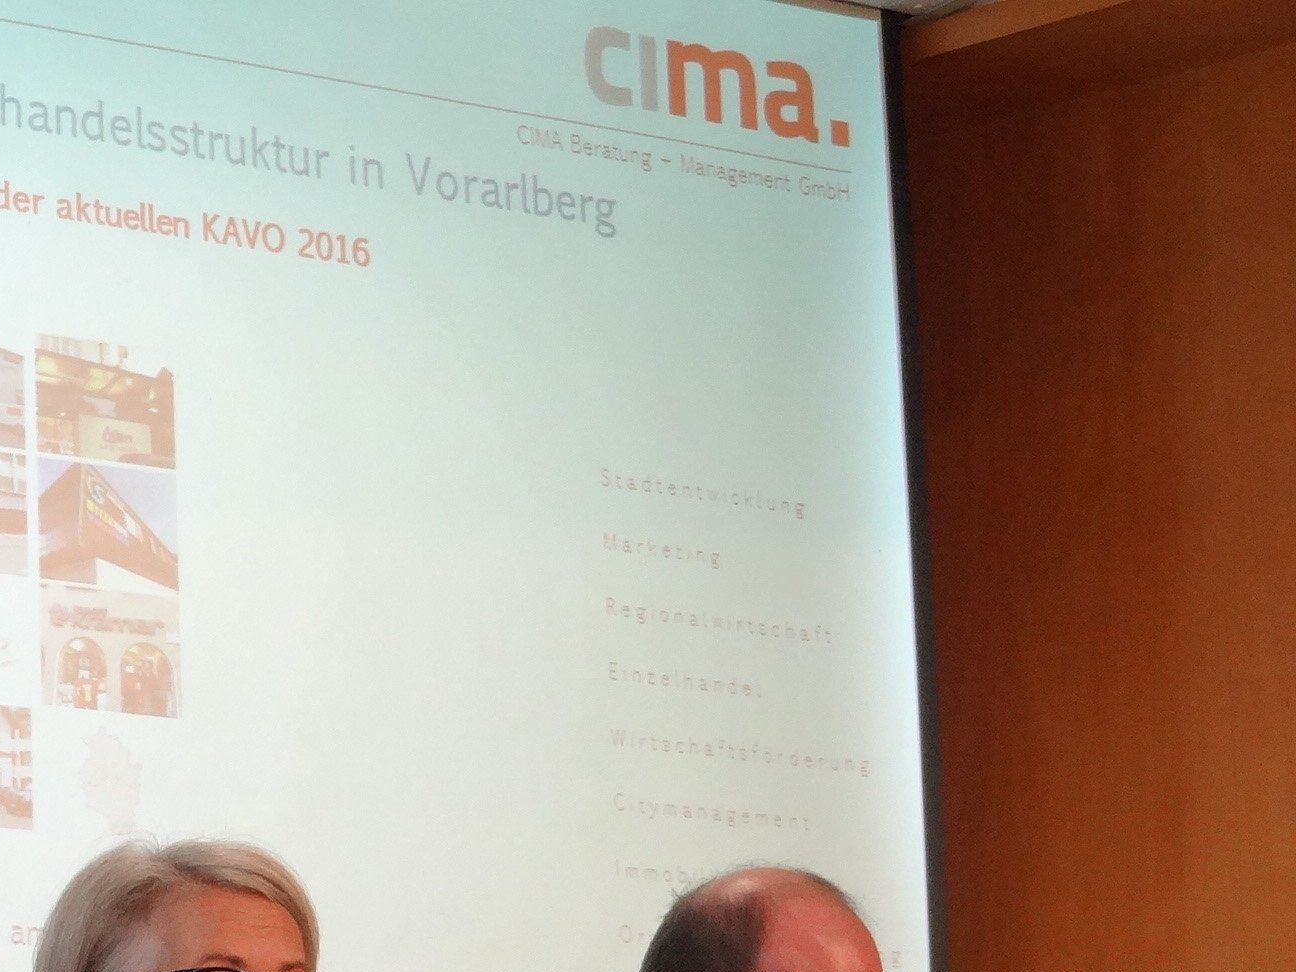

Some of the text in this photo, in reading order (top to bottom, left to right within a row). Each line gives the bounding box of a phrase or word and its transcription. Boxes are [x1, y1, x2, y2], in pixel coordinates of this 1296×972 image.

[348, 144, 384, 190] in
[406, 152, 618, 238] Vorarlberg
[570, 133, 652, 173] Beratung
[680, 154, 791, 192] Management
[798, 175, 851, 201] GmbH
[56, 192, 191, 240] aktuellen
[201, 211, 285, 254] KAVO
[298, 227, 371, 268] 2016
[602, 532, 721, 570] Marketing
